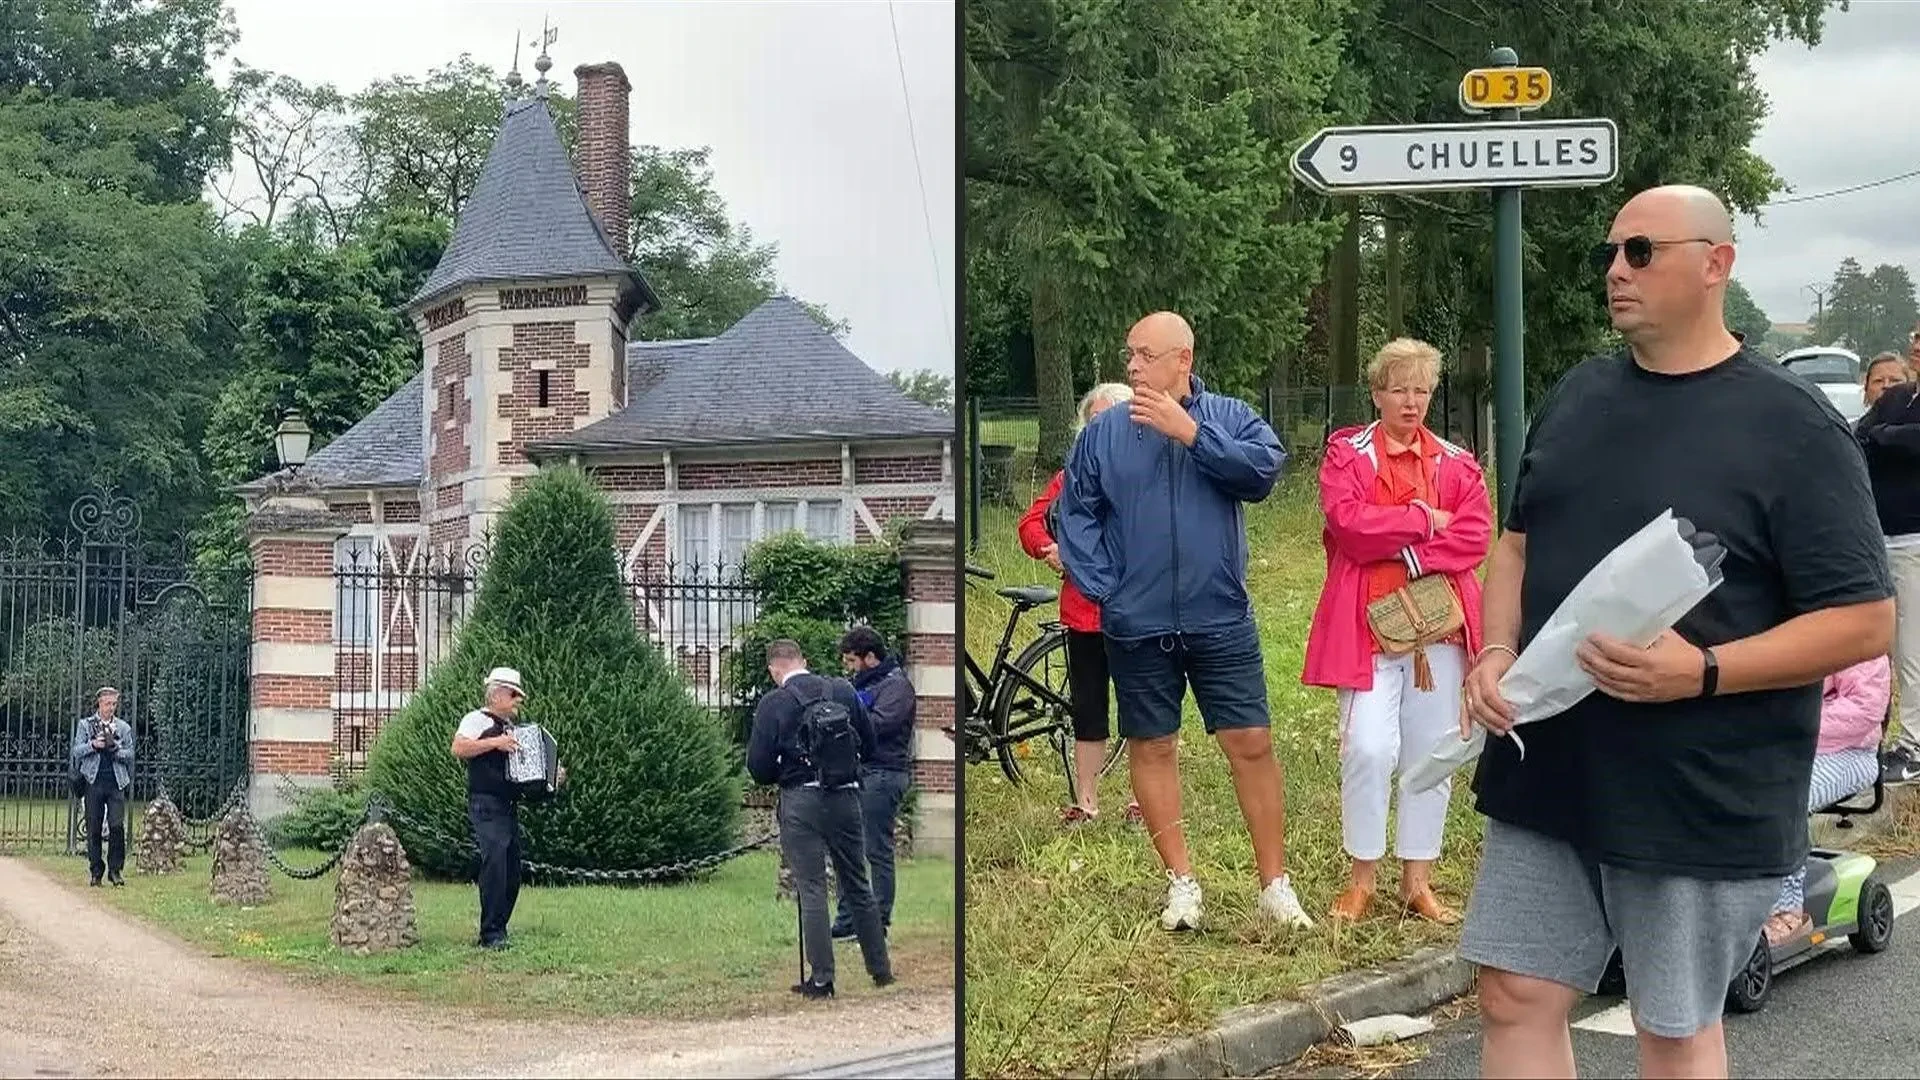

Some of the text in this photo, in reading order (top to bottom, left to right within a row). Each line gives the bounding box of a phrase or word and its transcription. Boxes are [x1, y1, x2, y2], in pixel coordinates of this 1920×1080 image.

[1471, 74, 1545, 101] D 35
[1339, 138, 1599, 172] 9 CHUELLES
